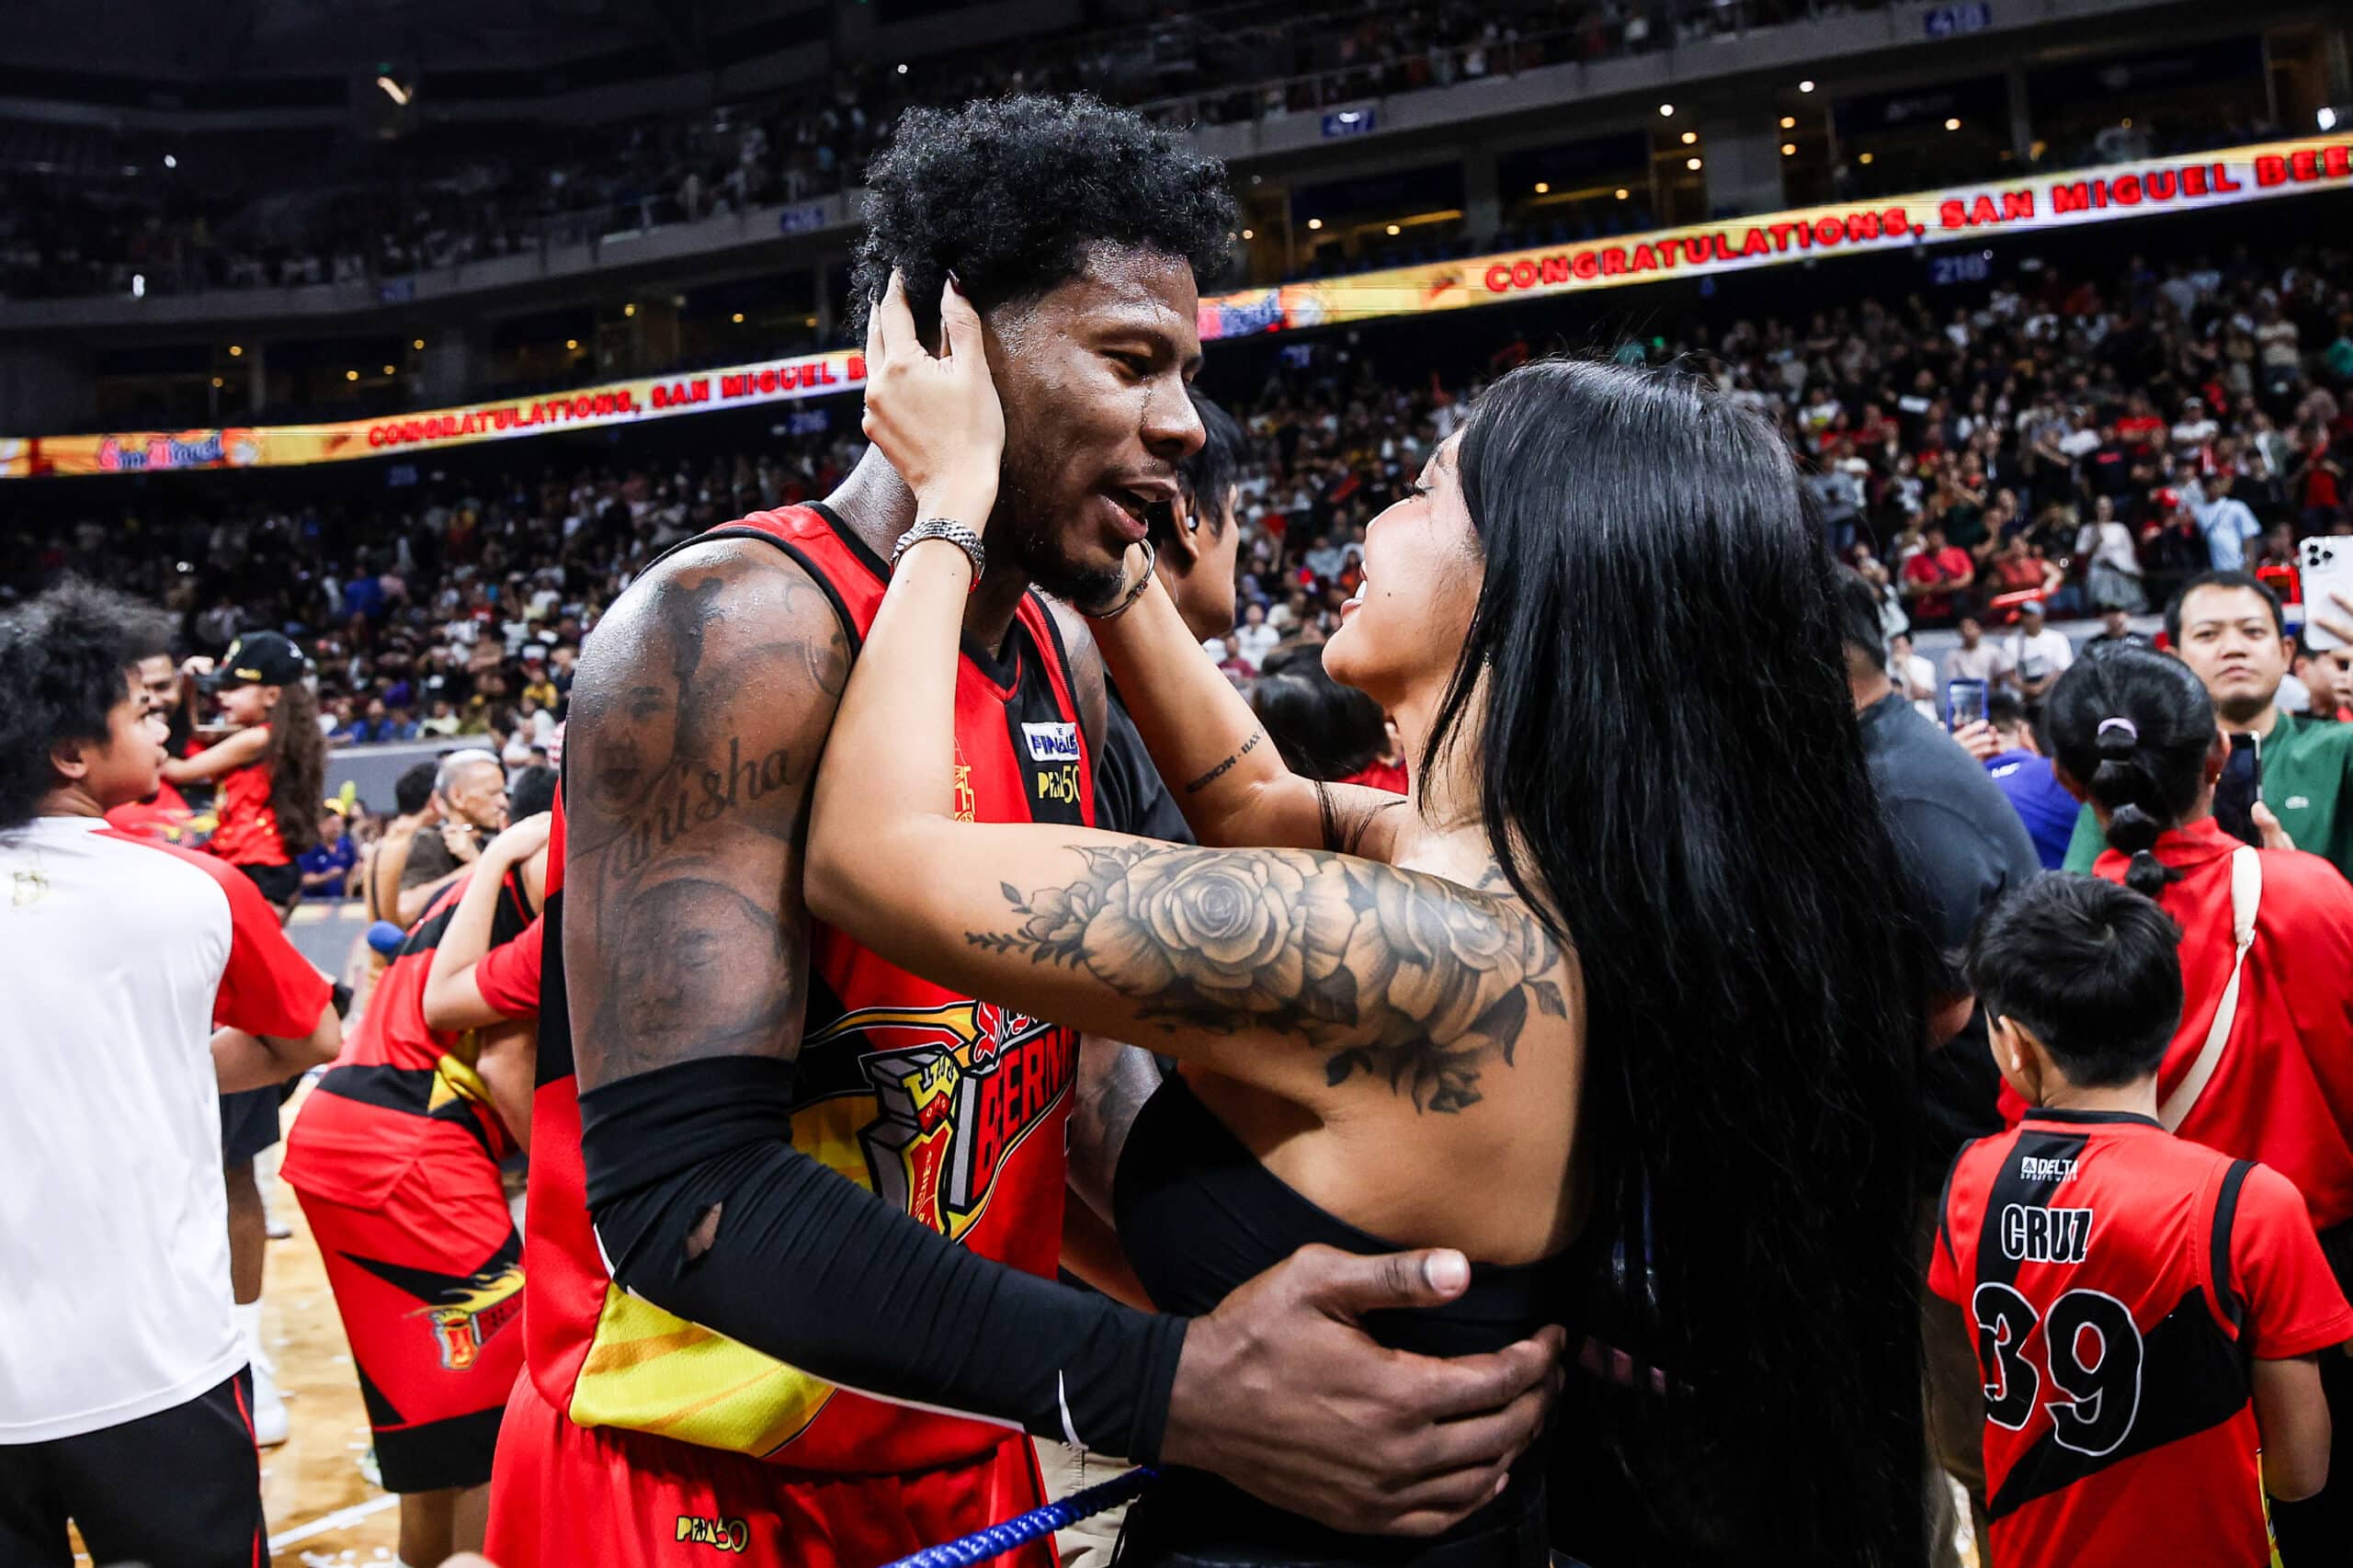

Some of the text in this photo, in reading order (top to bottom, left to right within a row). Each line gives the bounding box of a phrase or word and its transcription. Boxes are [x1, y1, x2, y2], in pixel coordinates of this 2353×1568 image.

[1484, 208, 1925, 292] CONGRATULATIONS,
[1939, 190, 2035, 230] SAN
[2051, 163, 2241, 214] MIGUEL
[369, 390, 641, 449] CONGRATULATIONS,
[652, 378, 710, 408] SAN
[722, 362, 837, 398] MIGUEL
[2037, 1158, 2078, 1177] DELTA
[2001, 1203, 2093, 1265] CRUZ
[1972, 1281, 2143, 1457] 39
